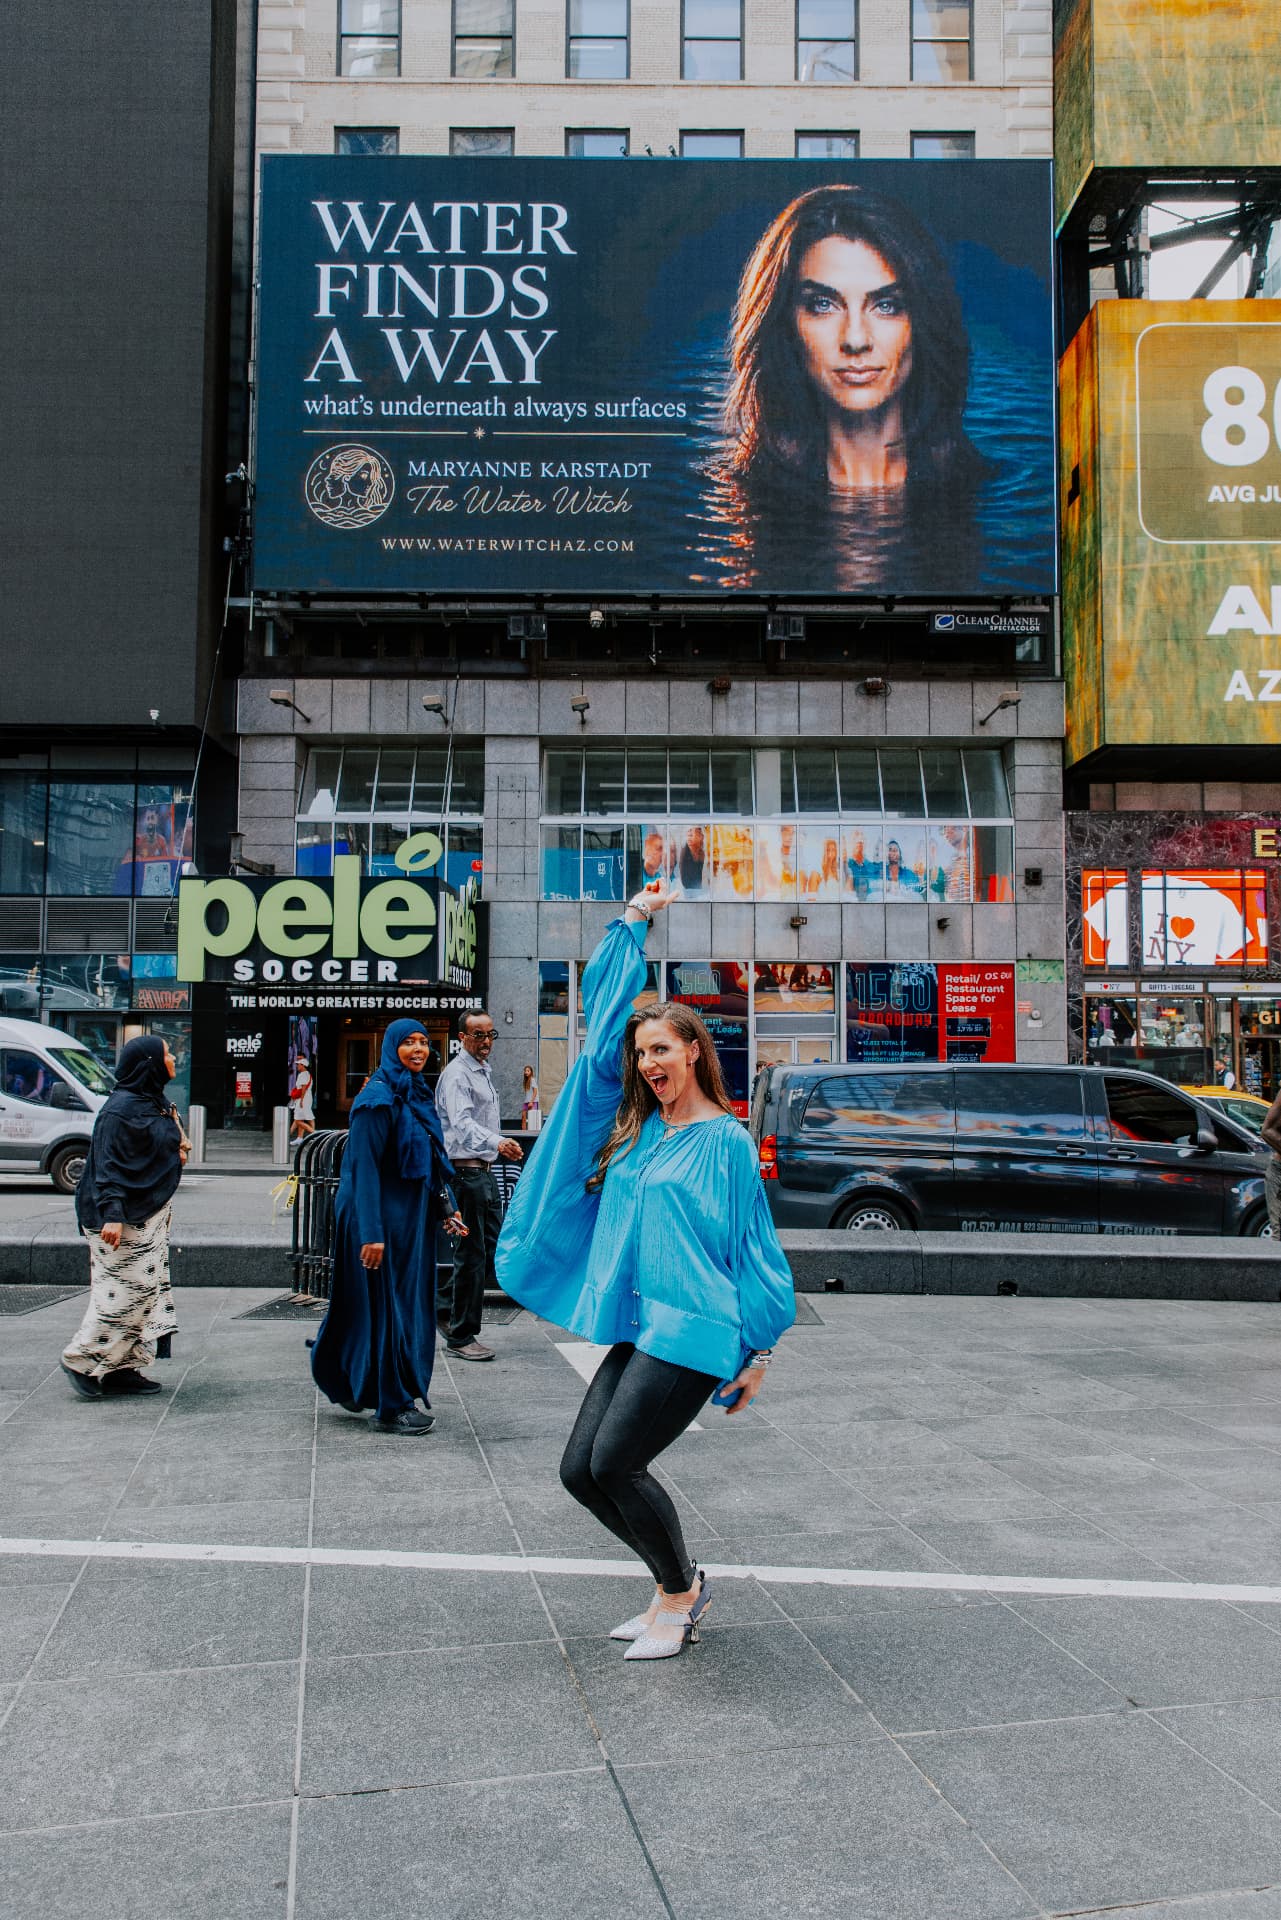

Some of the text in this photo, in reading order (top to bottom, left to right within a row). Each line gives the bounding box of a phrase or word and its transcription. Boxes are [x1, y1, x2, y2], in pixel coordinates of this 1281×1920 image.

[312, 201, 577, 255] WATER
[314, 263, 549, 320] FINDS
[304, 327, 558, 384] A WAY
[380, 394, 506, 417] underneath
[513, 395, 588, 423] always
[594, 396, 687, 418] surfaces
[1200, 365, 1281, 466] 8
[407, 460, 652, 479] MARYANNE KARSTADT
[406, 485, 633, 515] The Water Witch
[1207, 484, 1256, 503] AVG
[381, 538, 634, 552] WWW.WATERWITCHAZ.COM
[1206, 585, 1281, 635] A
[177, 832, 443, 981] pelé
[233, 958, 399, 983] SOCCER
[945, 974, 981, 984] Retail/
[856, 972, 931, 1011] 1560
[945, 984, 1005, 993] Restaurant
[945, 993, 996, 1004] Space for
[231, 996, 482, 1009] THE WORLD'S GREATEST SOCCER STORE
[945, 1003, 977, 1013] Lease
[858, 1013, 931, 1026] BROADWAY
[226, 1032, 263, 1053] pelé
[1023, 1222, 1036, 1231] 923
